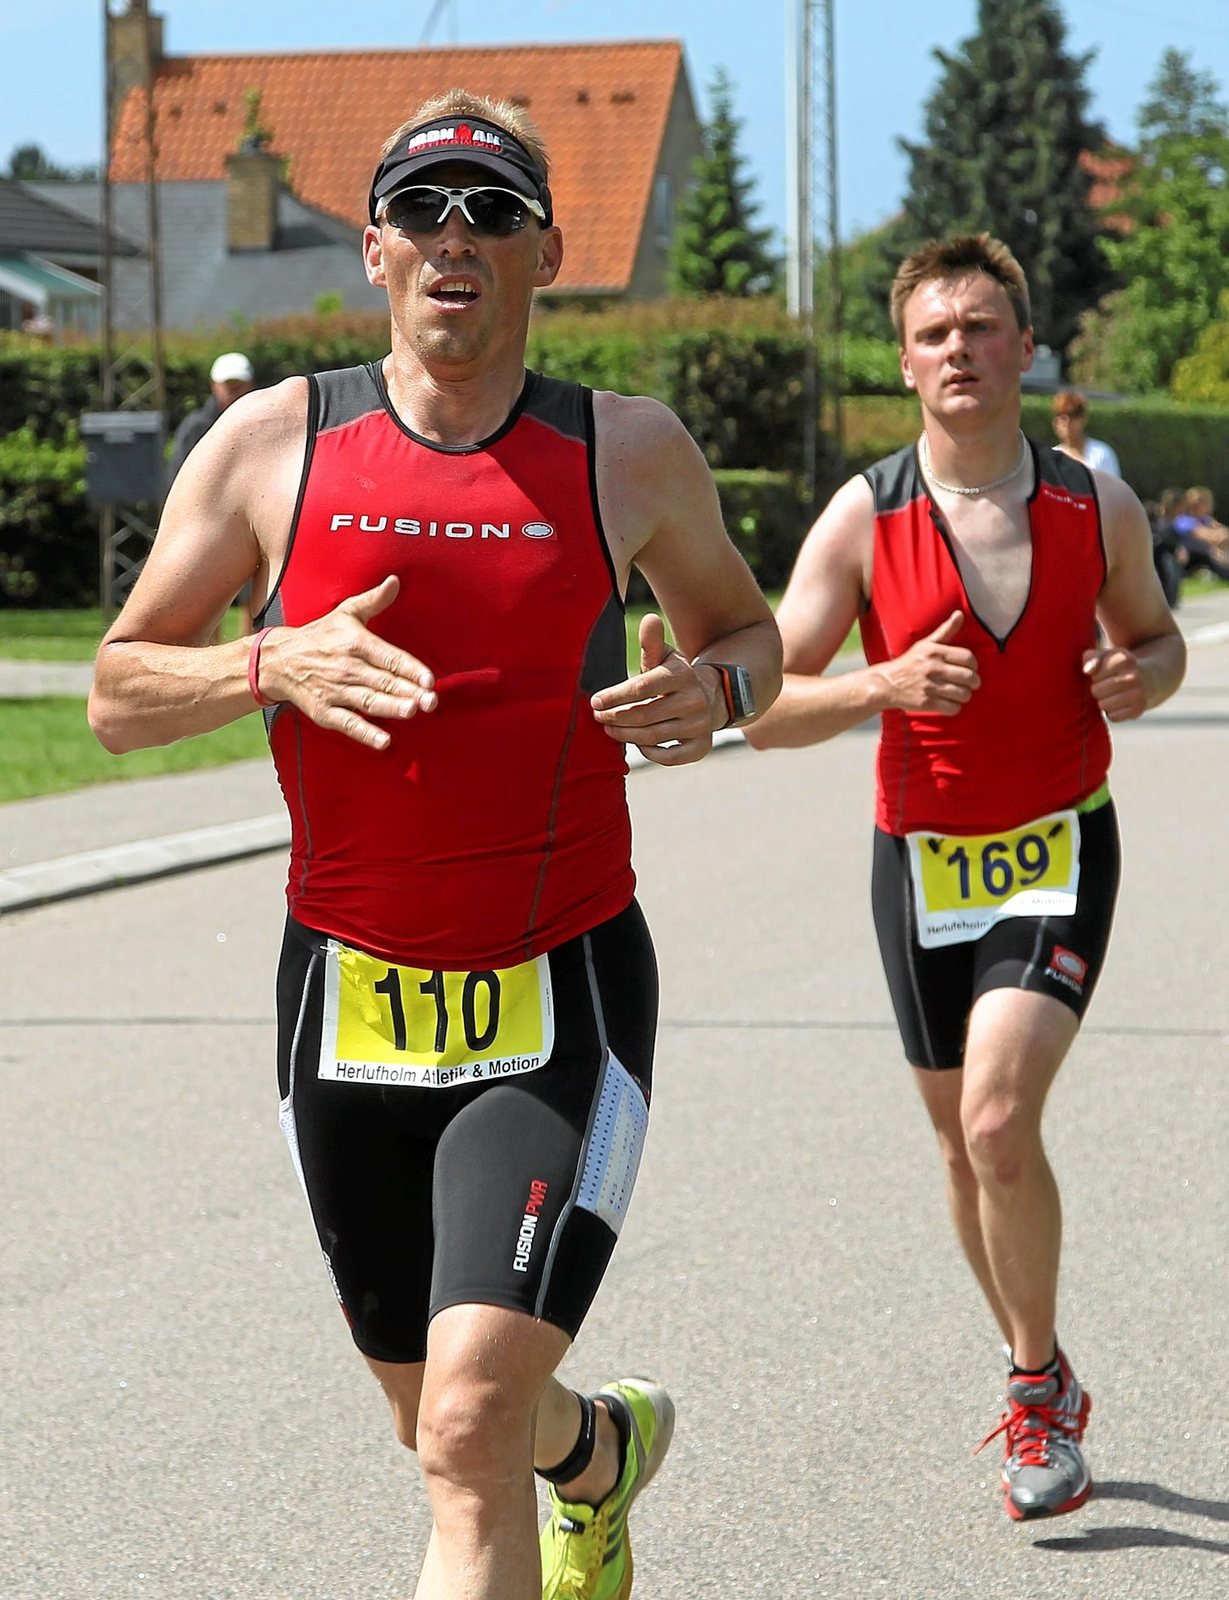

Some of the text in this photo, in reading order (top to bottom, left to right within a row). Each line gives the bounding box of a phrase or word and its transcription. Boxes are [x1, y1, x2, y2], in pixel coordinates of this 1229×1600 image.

[330, 514, 510, 538] FUSION
[947, 834, 1050, 900] 169
[374, 968, 501, 1053] 110
[336, 1057, 540, 1085] Herlufholm Atletik & Motion
